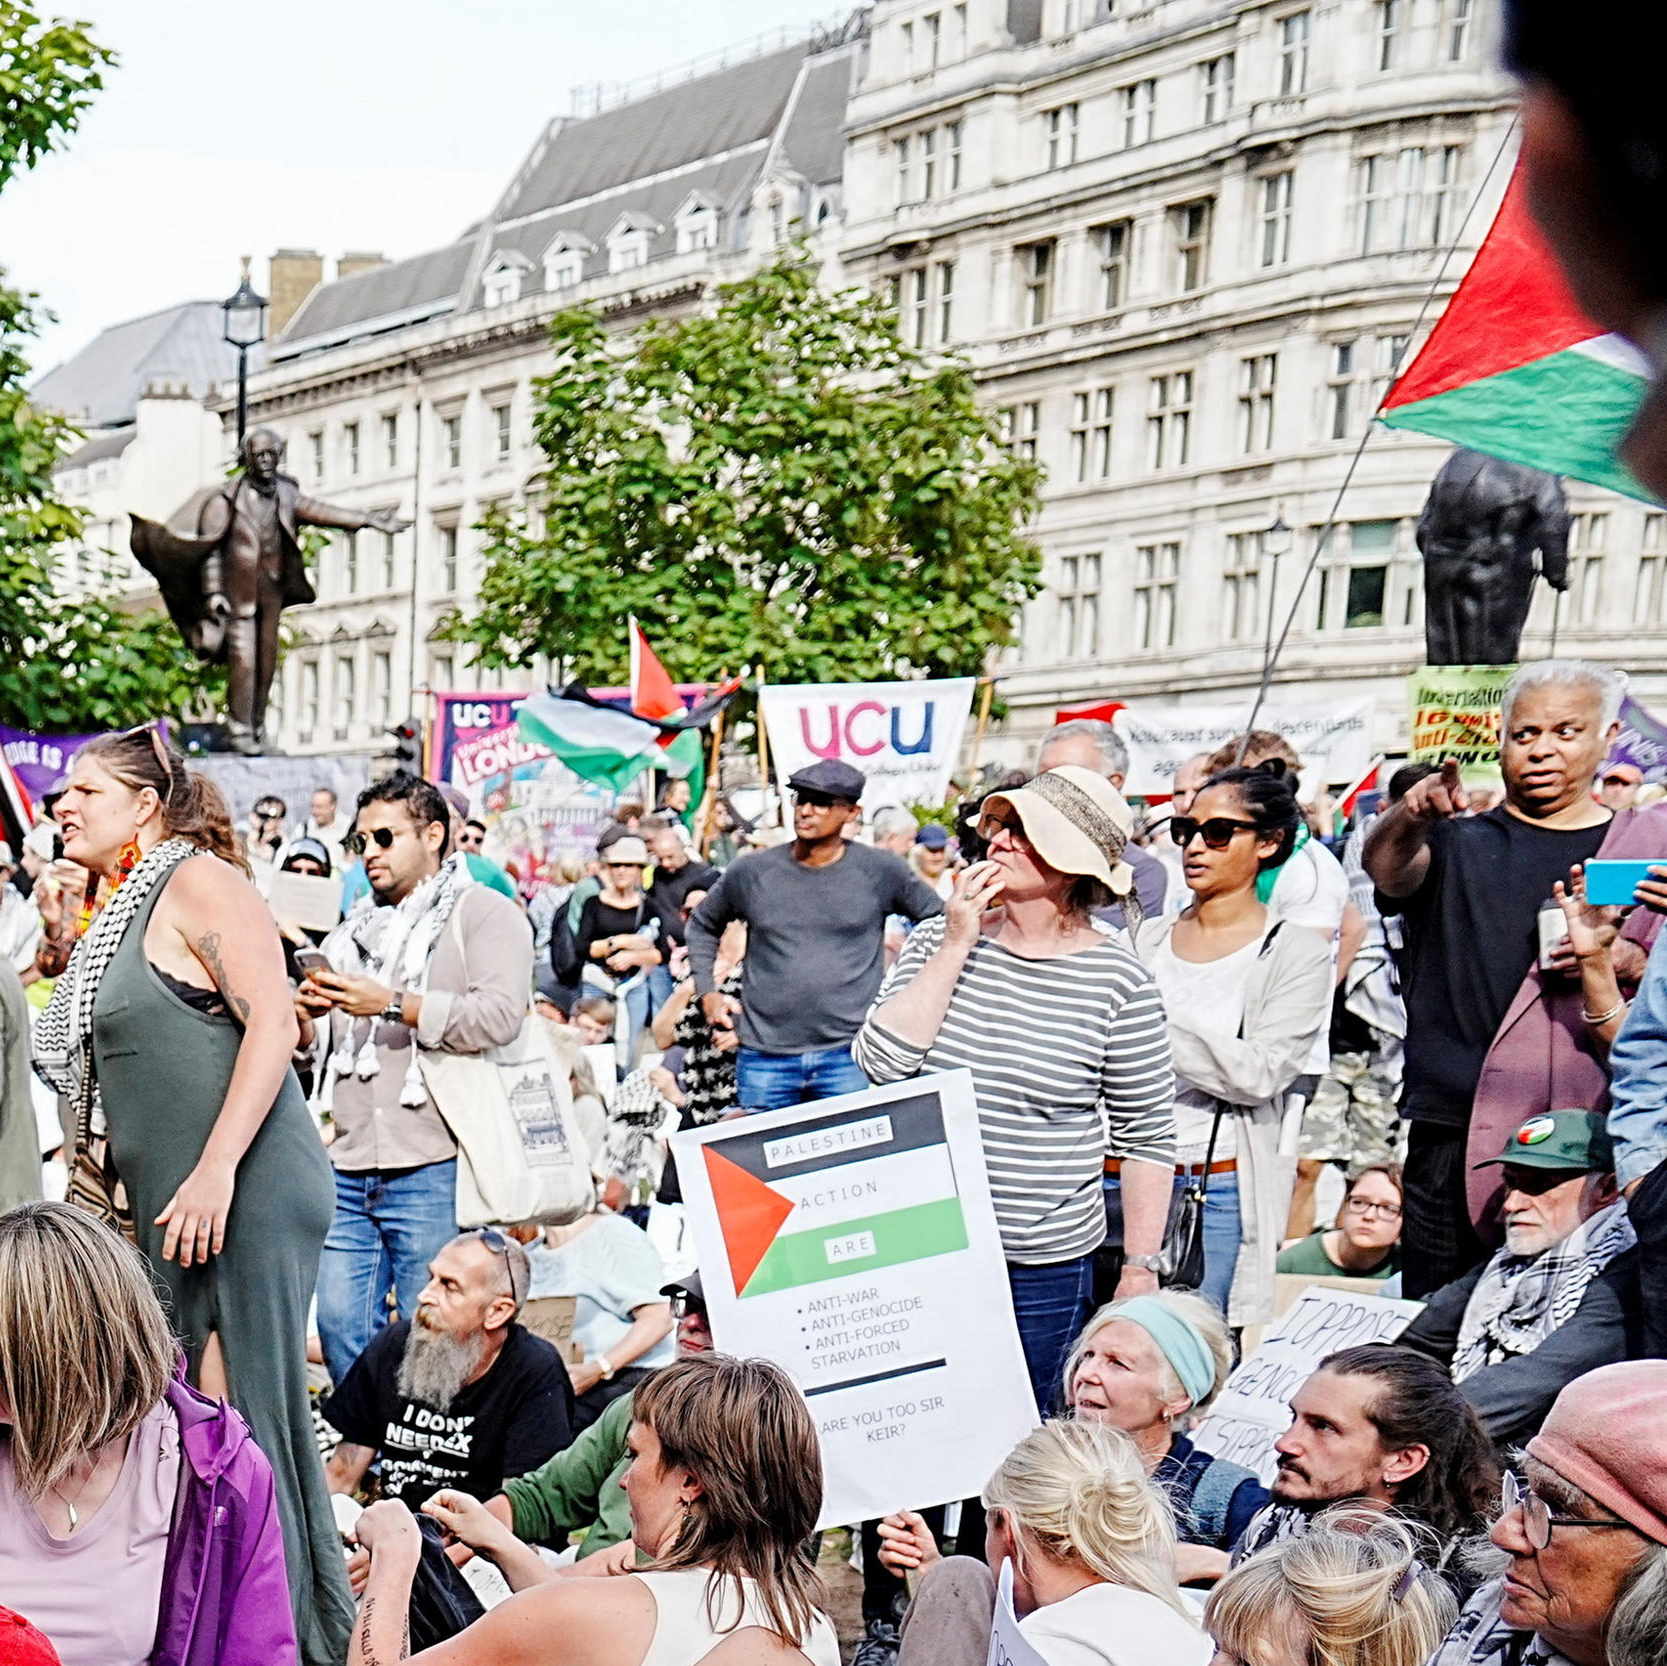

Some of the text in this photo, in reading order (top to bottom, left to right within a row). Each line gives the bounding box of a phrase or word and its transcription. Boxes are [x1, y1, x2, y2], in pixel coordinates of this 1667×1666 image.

[452, 703, 510, 728] UCU
[799, 700, 934, 760] UCU
[42, 743, 63, 770] IS
[771, 1123, 886, 1160] PALESTINE
[801, 1180, 879, 1210] ACTION
[833, 1237, 870, 1256] ARE
[807, 1287, 880, 1315] ANTI-WAR
[811, 1296, 924, 1332] ANTI-GENOCIDE
[816, 1319, 911, 1351] ANTI-FORCED
[1263, 1298, 1413, 1354] I OPPOSE
[811, 1339, 902, 1370] STARVATION
[403, 1404, 414, 1422] I
[821, 1395, 945, 1434] ARE YOU TOO SIR
[386, 1422, 445, 1450] NEED
[866, 1422, 907, 1444] KEIR?
